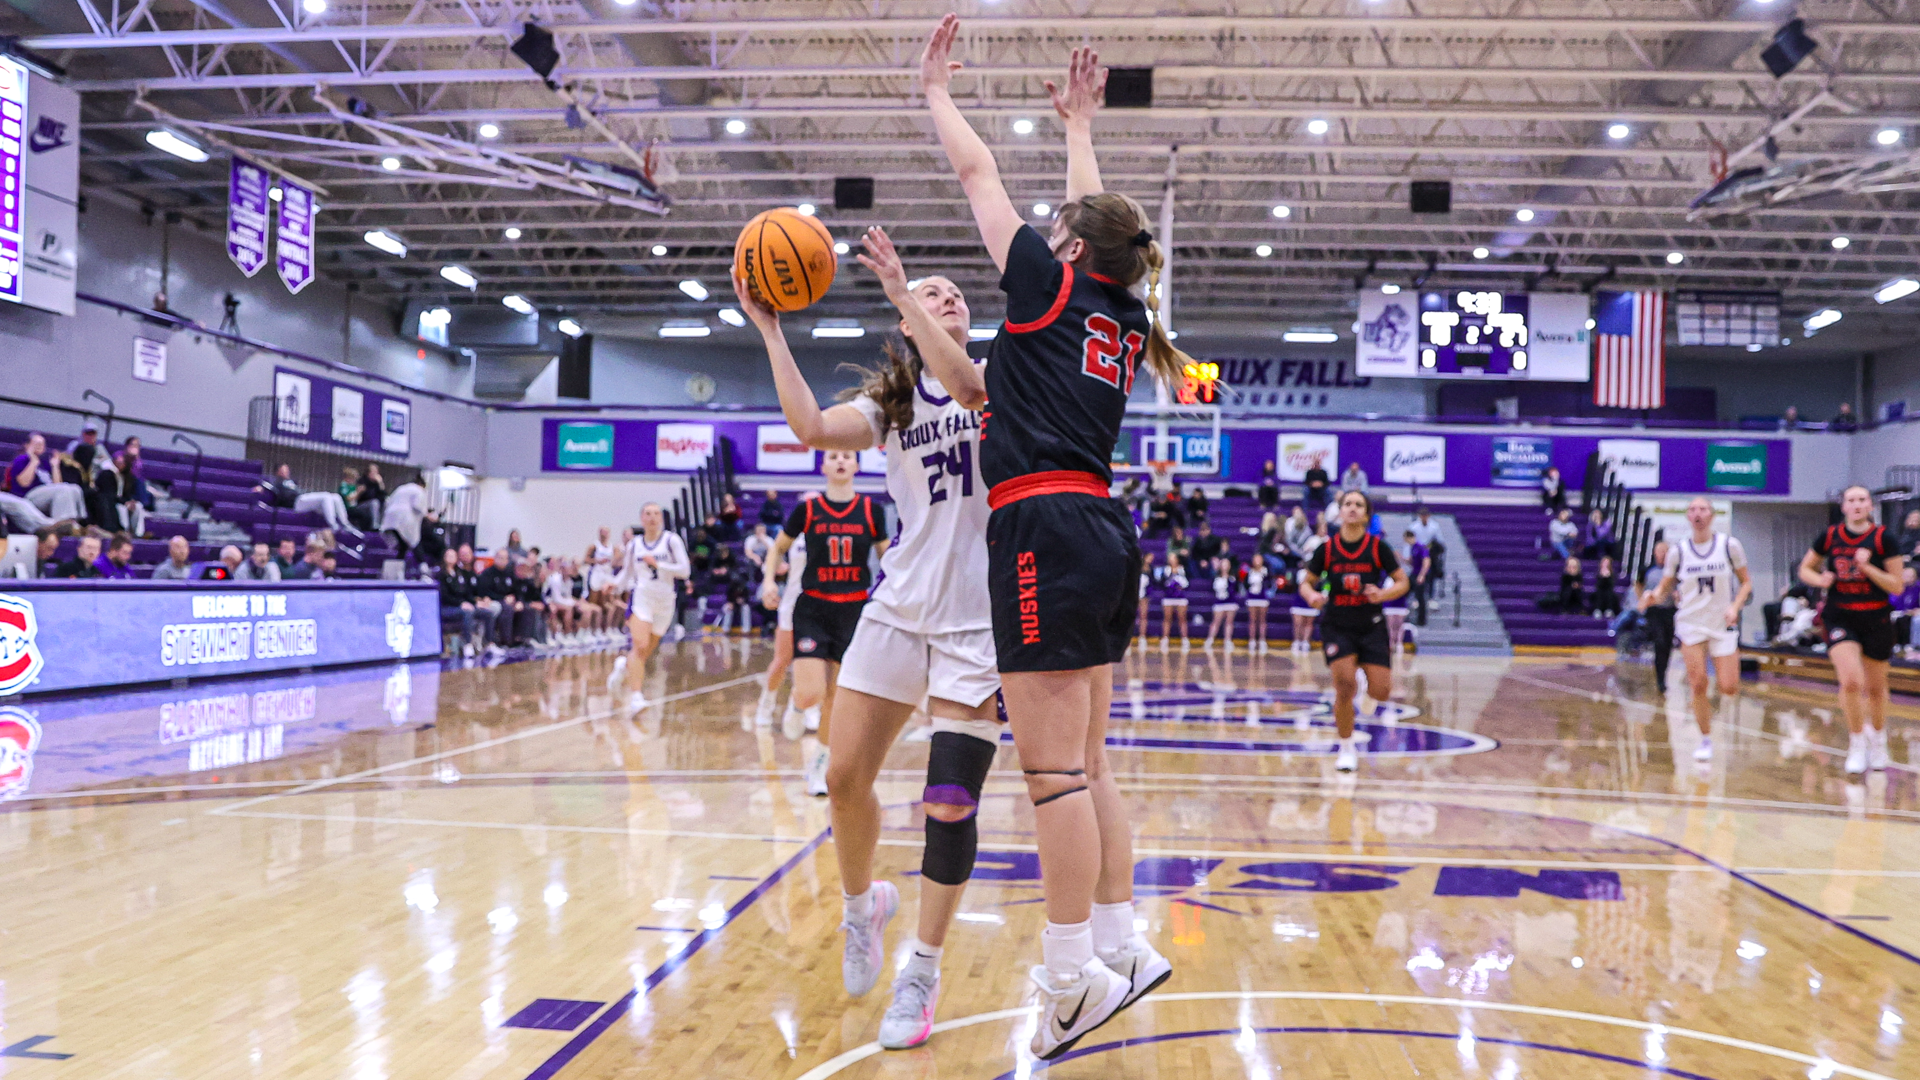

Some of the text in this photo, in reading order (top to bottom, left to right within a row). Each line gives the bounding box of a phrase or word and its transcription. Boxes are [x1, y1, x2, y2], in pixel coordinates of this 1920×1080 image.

[1082, 311, 1146, 397] 21
[898, 420, 942, 451] SIOUX
[921, 441, 973, 506] 24
[827, 535, 853, 565] 11
[817, 566, 862, 582] STATE
[192, 594, 287, 618] WELCOME TO THE
[1017, 551, 1041, 645] HUSKIES
[161, 618, 317, 666] STEWART CENTER
